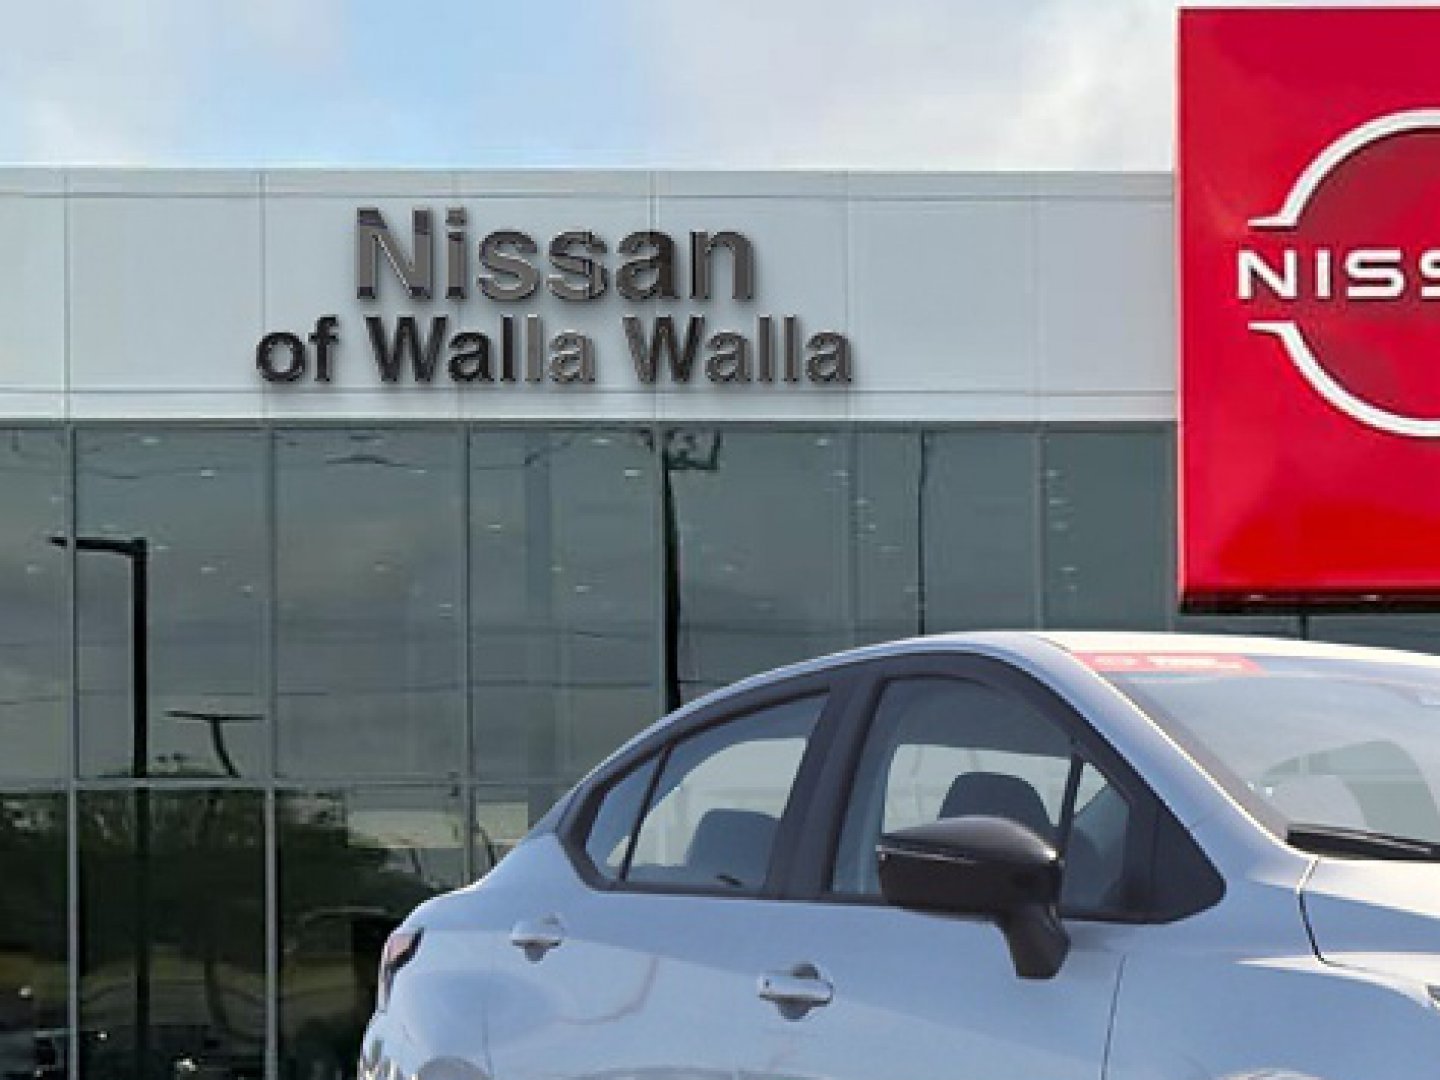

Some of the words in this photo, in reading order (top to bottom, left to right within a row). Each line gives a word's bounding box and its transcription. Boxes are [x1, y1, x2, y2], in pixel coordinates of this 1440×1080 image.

[356, 206, 756, 300] Nissan
[256, 314, 339, 382] of
[364, 314, 596, 382] Walla
[622, 314, 853, 383] Walla
